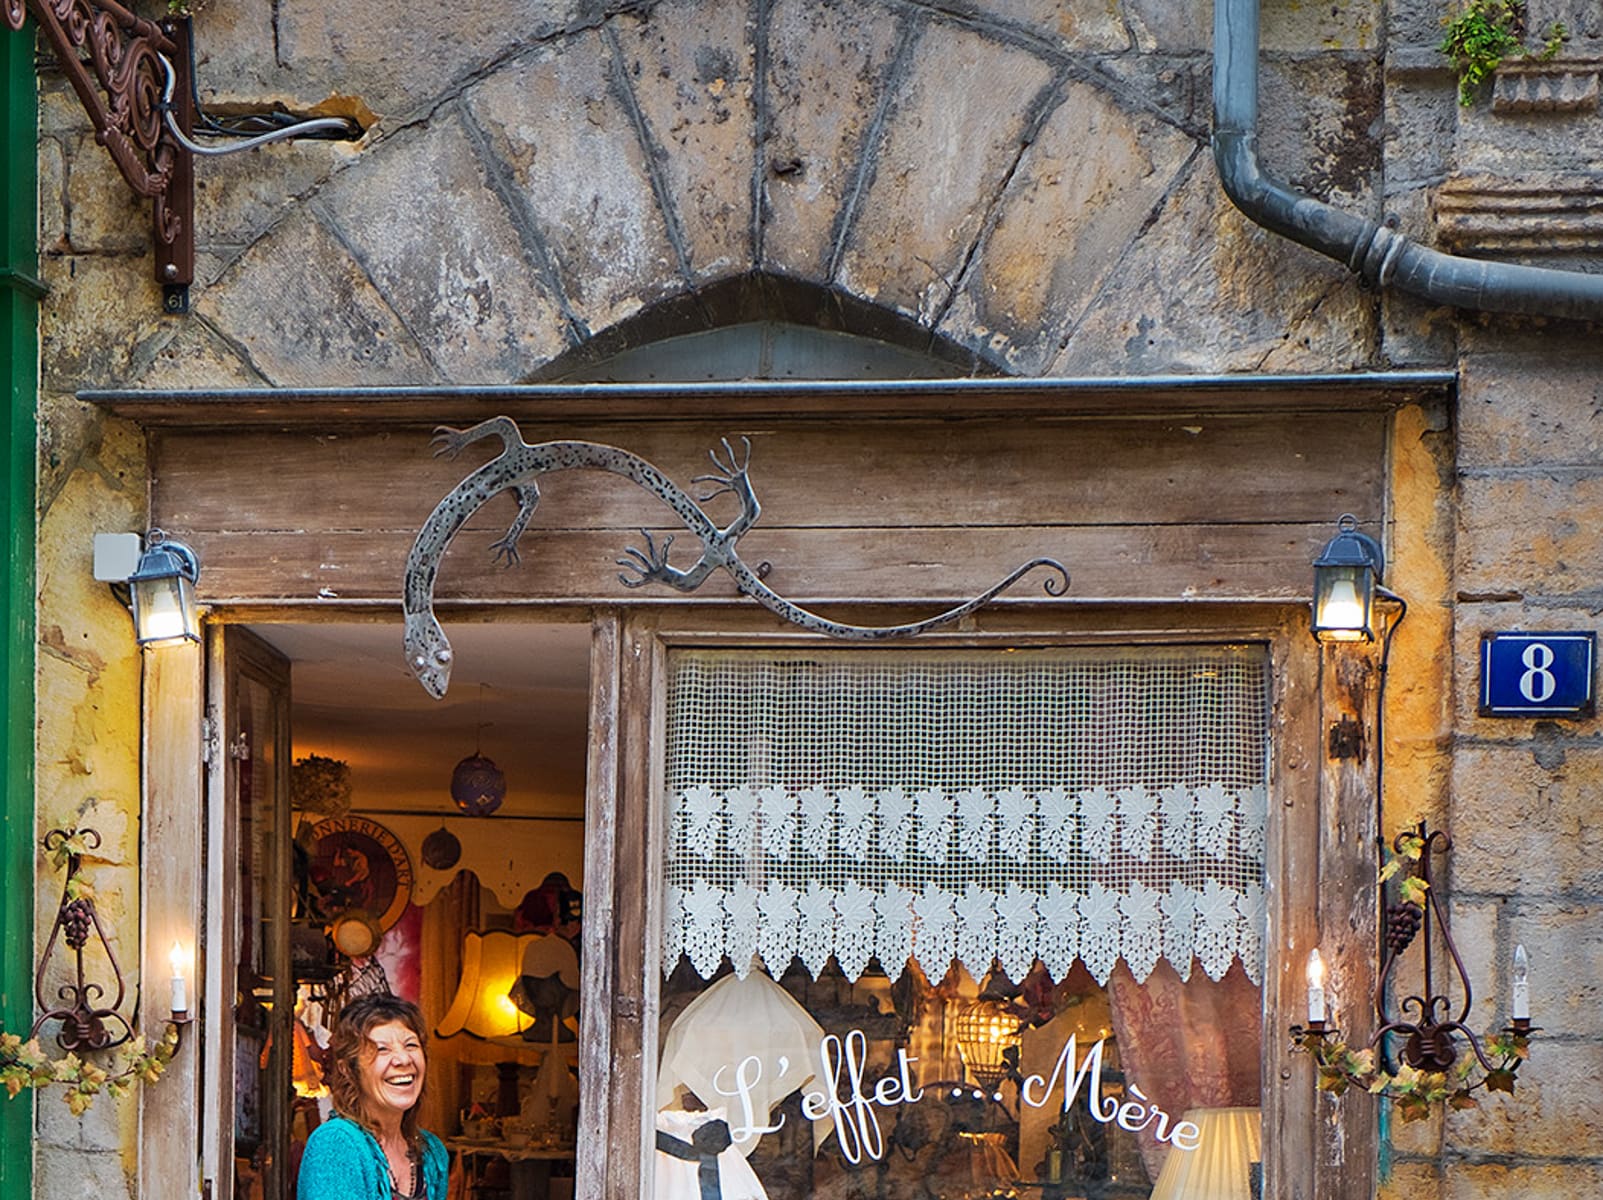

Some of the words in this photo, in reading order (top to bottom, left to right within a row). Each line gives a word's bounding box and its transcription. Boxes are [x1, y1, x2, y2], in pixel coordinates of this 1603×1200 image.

[169, 294, 183, 308] 61
[1519, 642, 1556, 703] 8
[1021, 1032, 1201, 1151] Mère
